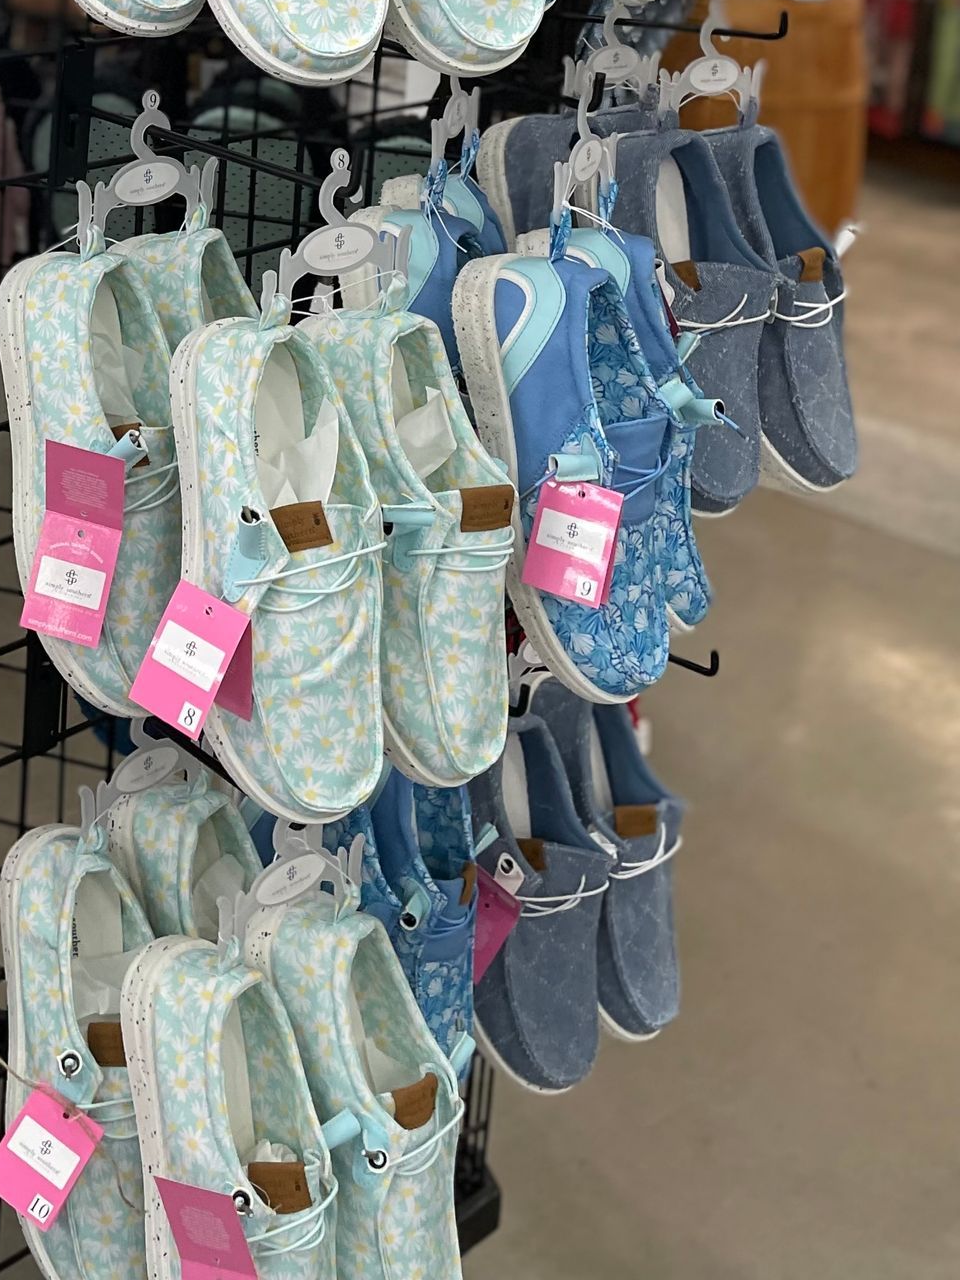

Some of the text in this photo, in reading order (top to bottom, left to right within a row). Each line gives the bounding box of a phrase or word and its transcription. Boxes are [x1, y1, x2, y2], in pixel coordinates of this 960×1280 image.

[149, 93, 157, 108] 9
[338, 153, 345, 169] 8
[580, 580, 592, 596] 9
[184, 707, 196, 726] 8
[30, 1197, 51, 1219] 10
